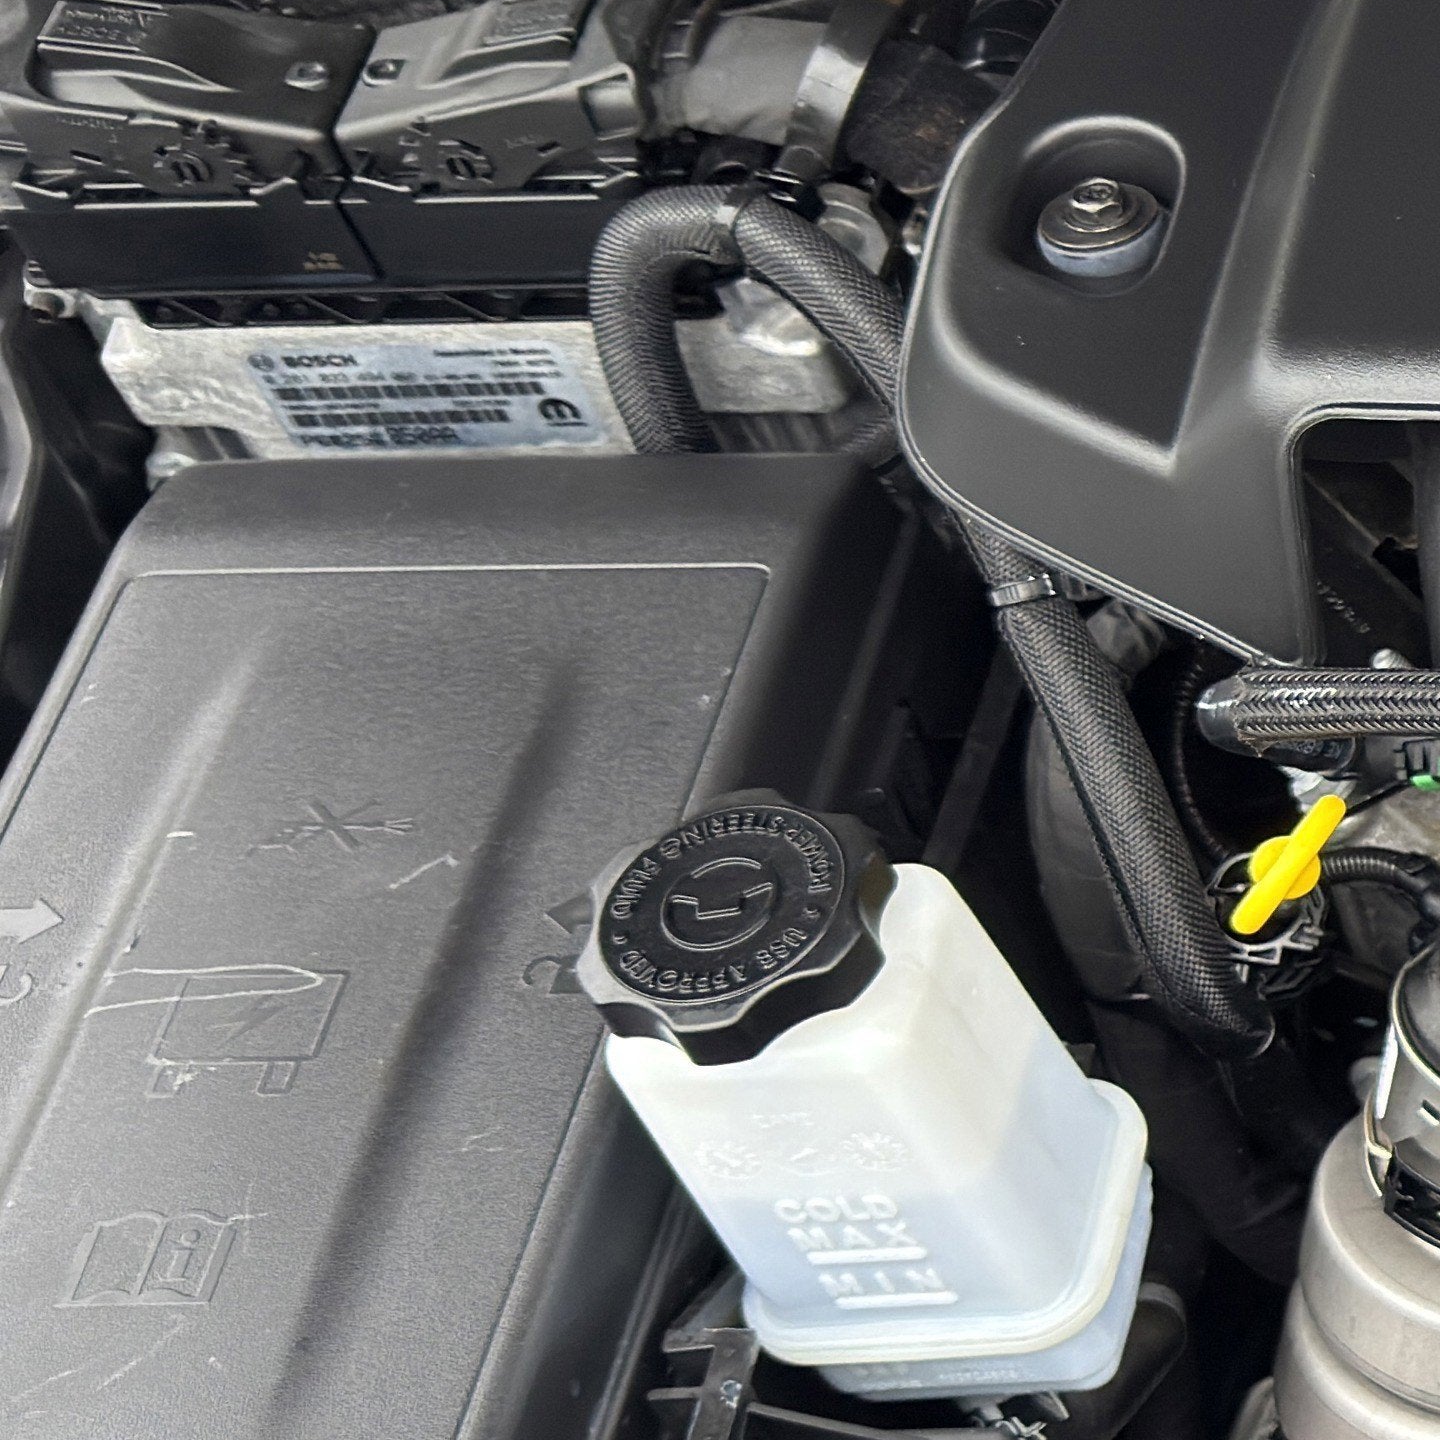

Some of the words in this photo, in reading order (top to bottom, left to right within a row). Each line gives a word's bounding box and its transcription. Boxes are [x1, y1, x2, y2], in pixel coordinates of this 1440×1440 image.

[658, 812, 787, 860] STEERING
[610, 856, 664, 920] FLUID
[756, 926, 809, 971] USE
[618, 949, 749, 994] APPROVED
[774, 1193, 900, 1224] COLD
[787, 1221, 919, 1252] MAX
[817, 1268, 947, 1296] MIN
